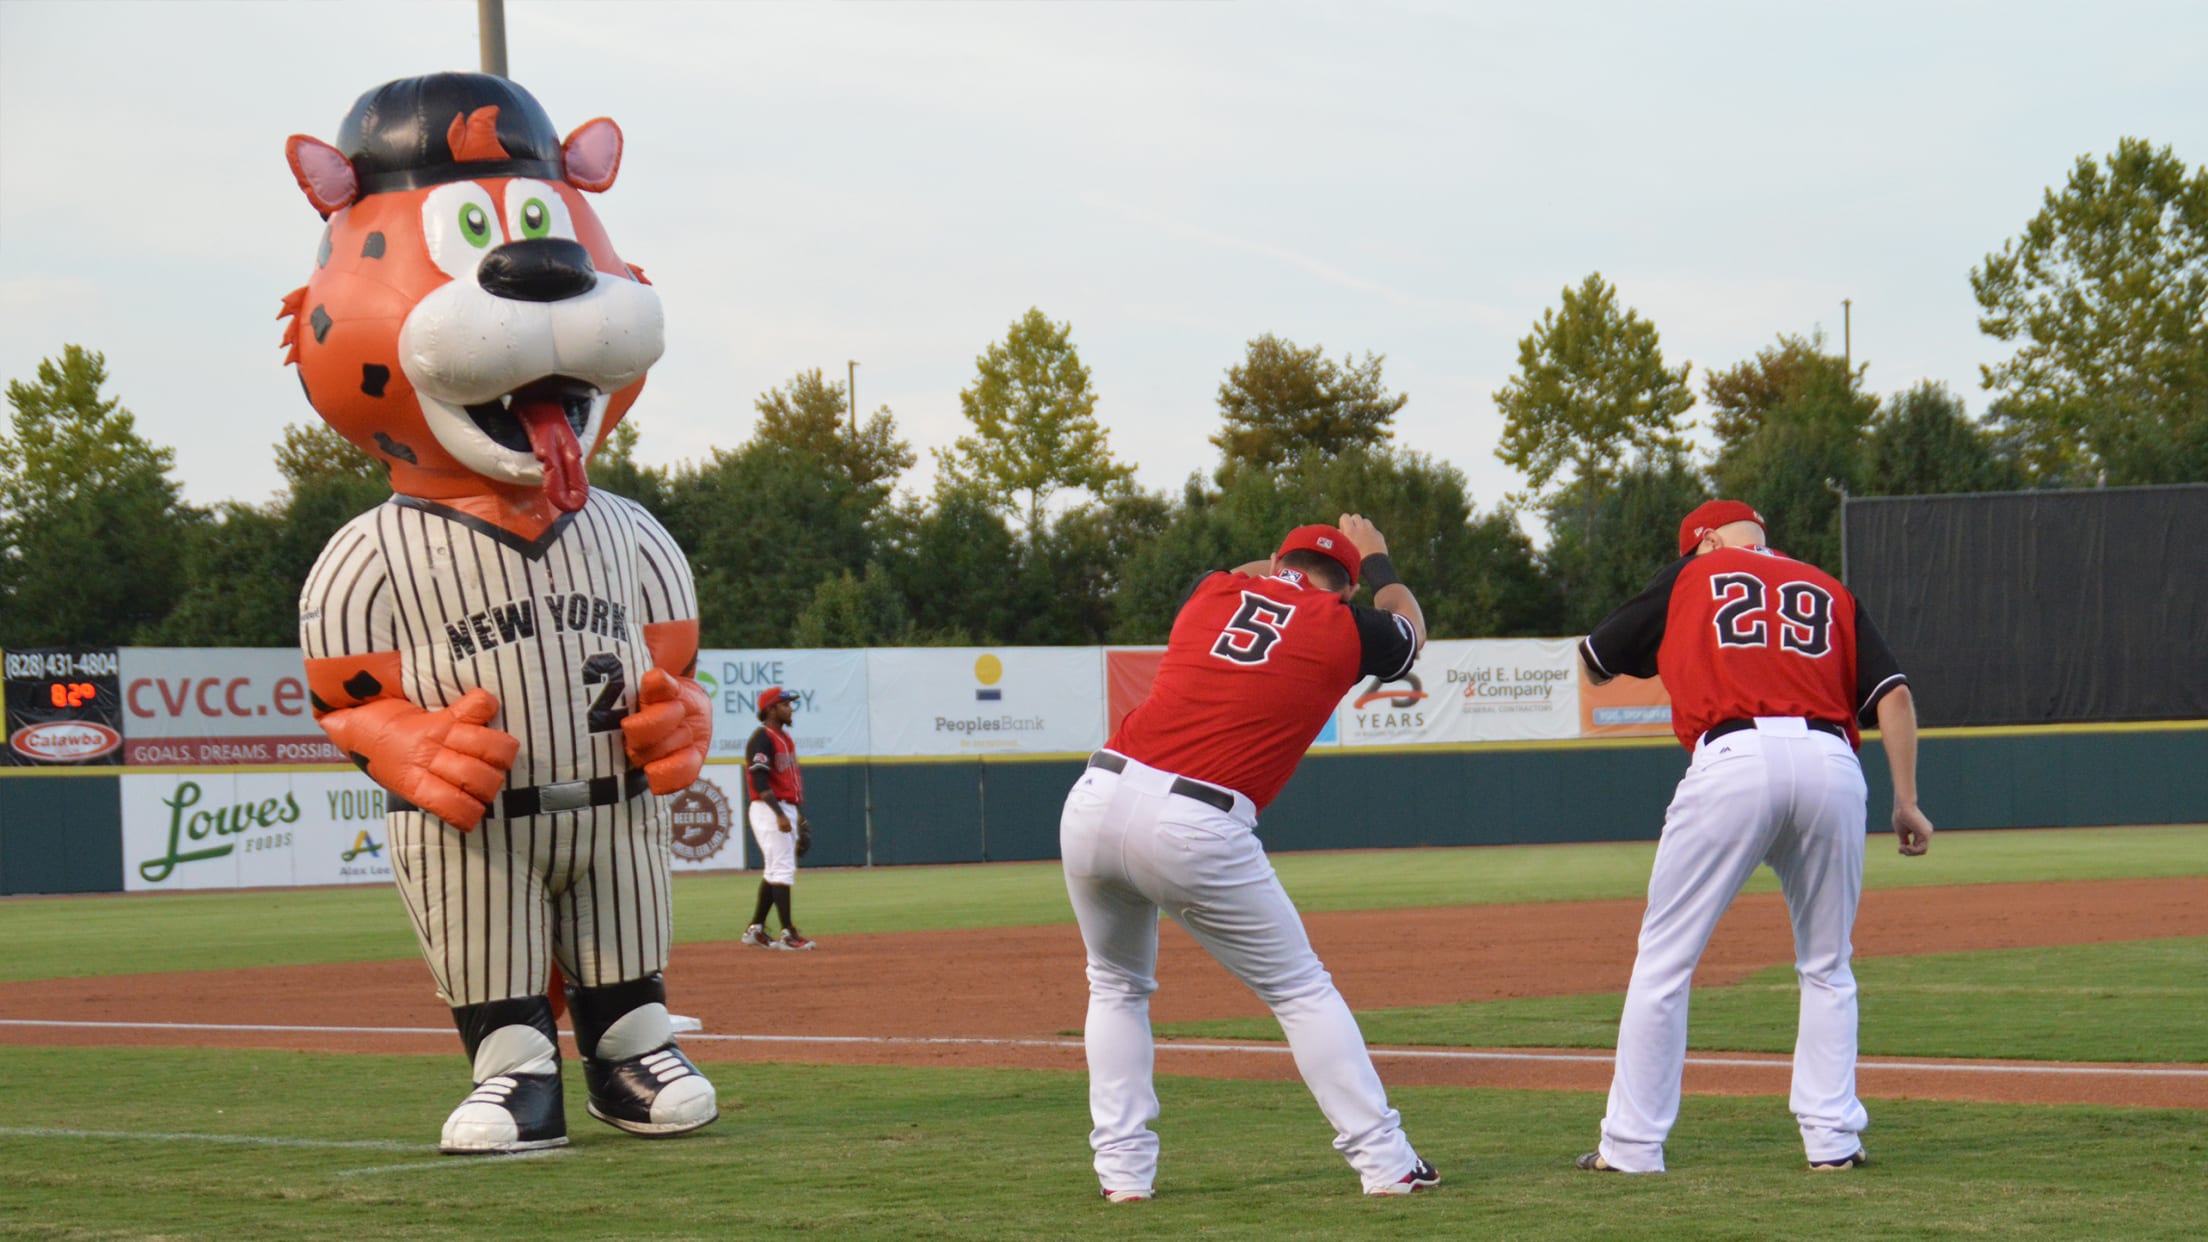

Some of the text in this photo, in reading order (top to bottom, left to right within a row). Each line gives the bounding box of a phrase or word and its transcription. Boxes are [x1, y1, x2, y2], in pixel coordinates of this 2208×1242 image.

[444, 591, 629, 662] NEW YORK
[1709, 571, 1834, 659] 29
[1209, 590, 1296, 666] 5
[723, 661, 784, 685] DUKE
[1446, 667, 1570, 684] David E. Looper
[127, 676, 305, 718] cvcc.e
[580, 651, 630, 736] 2
[724, 689, 816, 714] ENGY
[1477, 682, 1552, 699] Company
[1356, 712, 1425, 729] YEARS
[28, 733, 103, 748] Catawba
[134, 745, 195, 762] GOALS.
[200, 743, 271, 761] DREAMS.
[326, 789, 385, 821] YOUR
[139, 781, 300, 882] Lowes
[245, 832, 292, 853] FOODS
